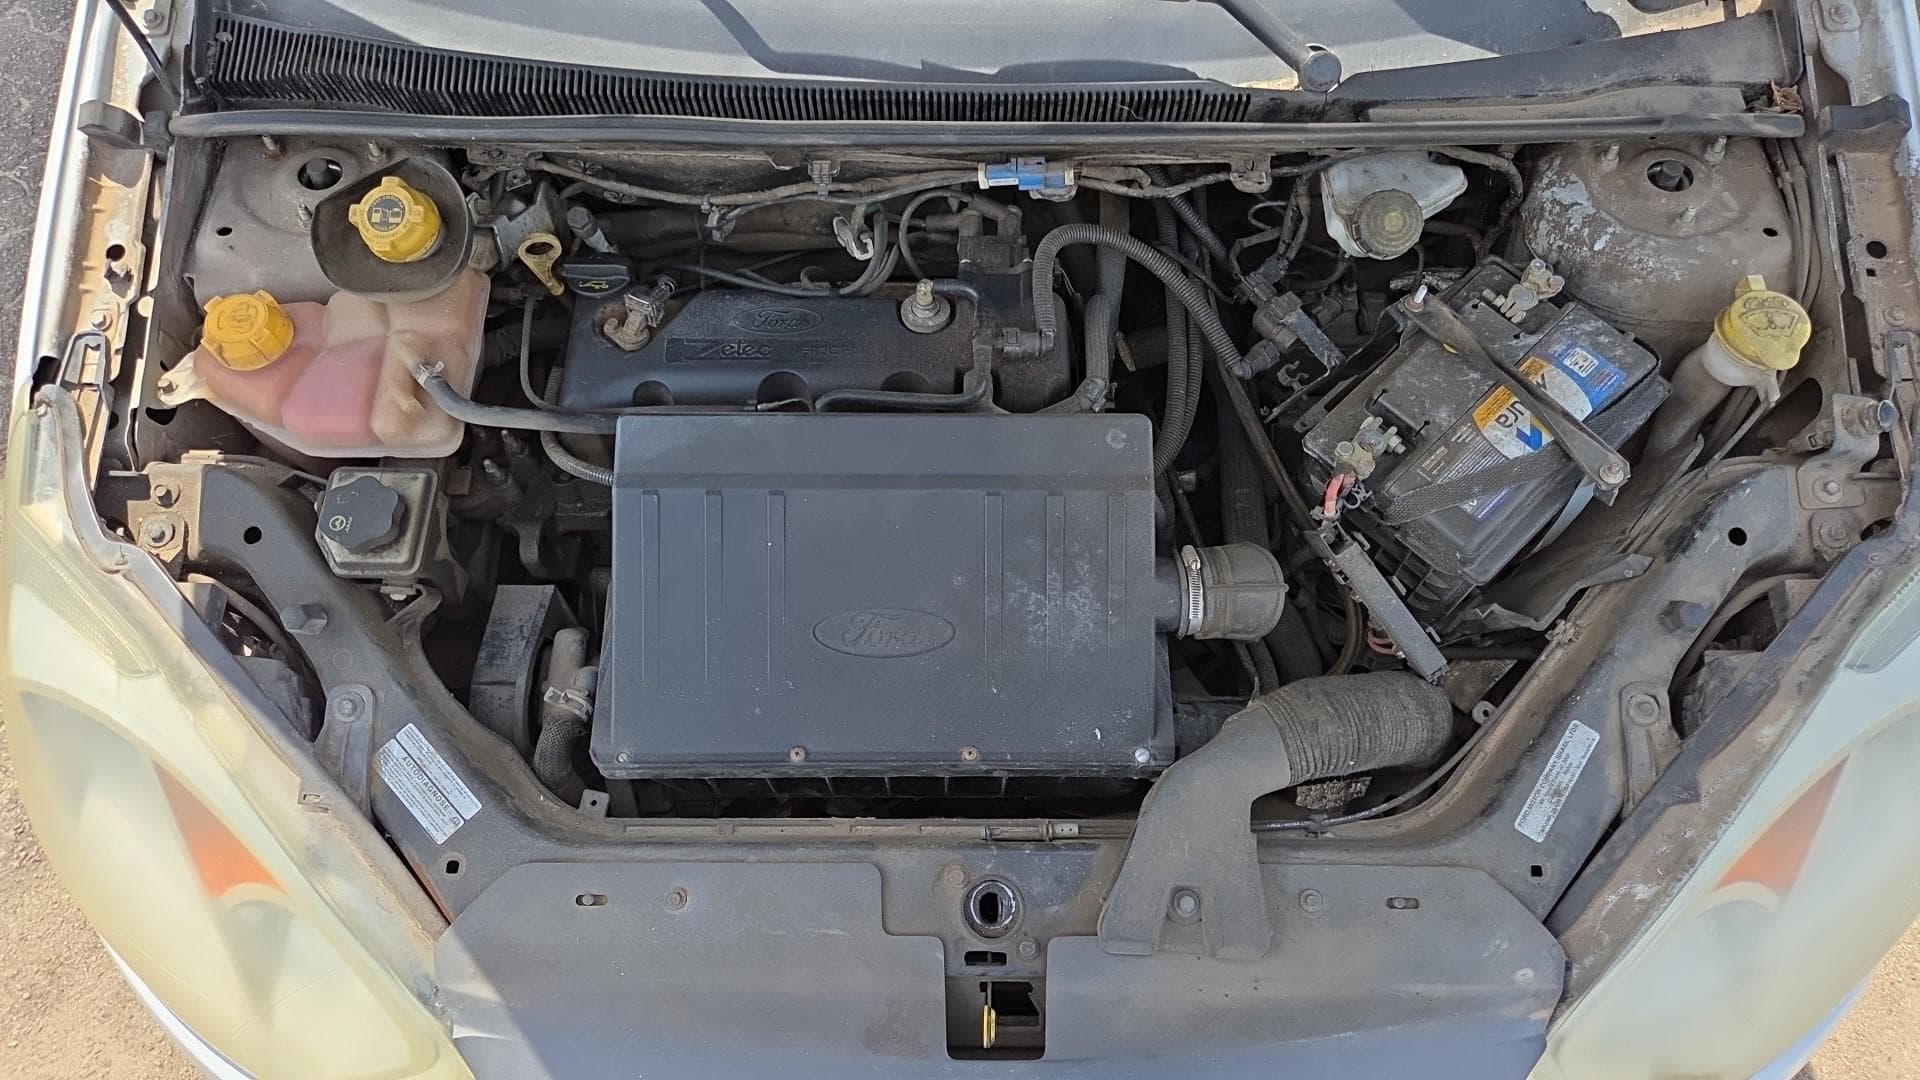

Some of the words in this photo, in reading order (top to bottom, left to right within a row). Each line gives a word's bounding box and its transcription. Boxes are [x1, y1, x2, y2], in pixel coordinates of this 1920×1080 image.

[752, 310, 810, 330] Ford
[842, 612, 926, 648] Ford
[402, 756, 451, 811] AUTODIAGNOSE
